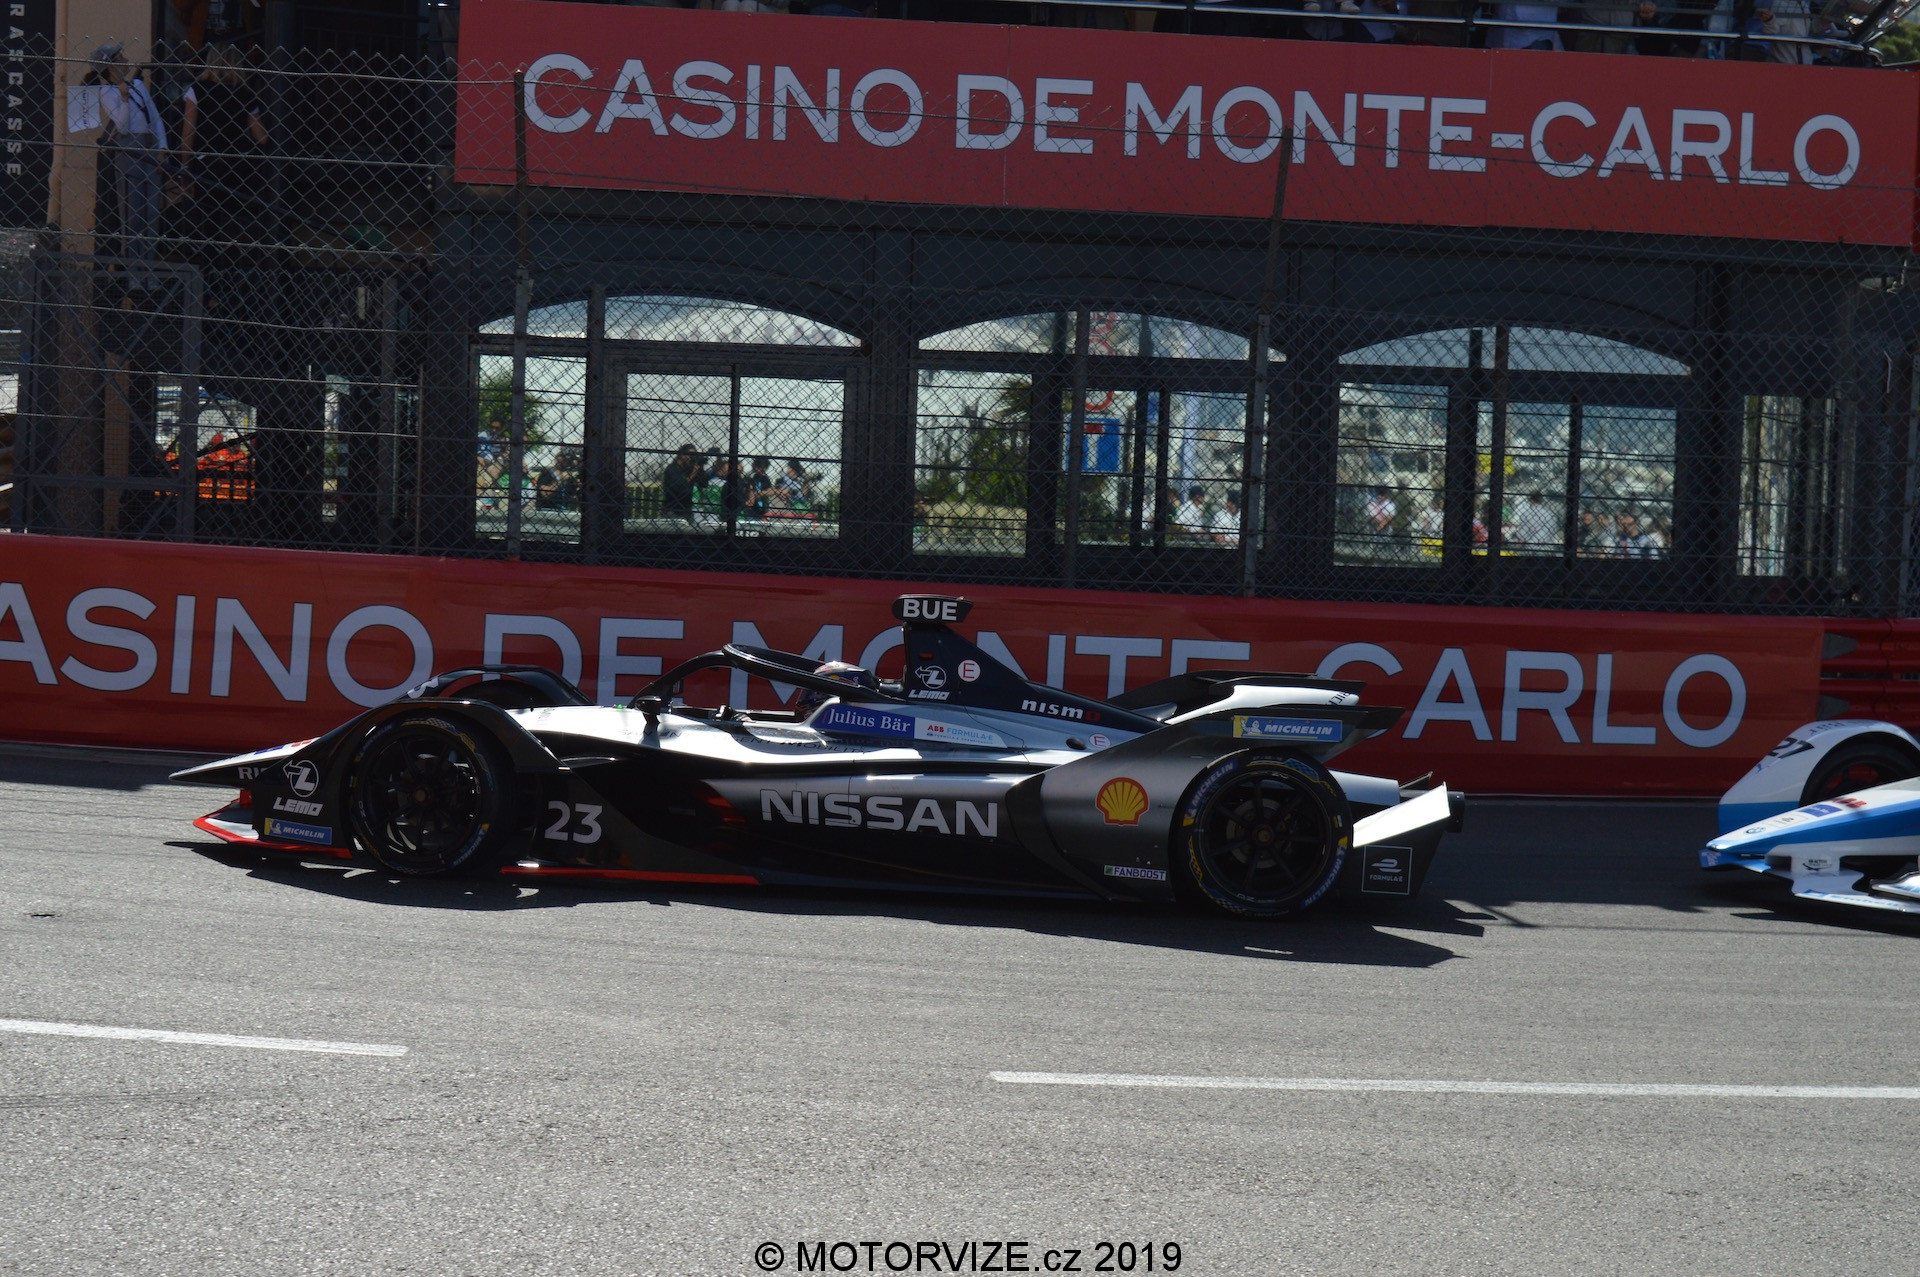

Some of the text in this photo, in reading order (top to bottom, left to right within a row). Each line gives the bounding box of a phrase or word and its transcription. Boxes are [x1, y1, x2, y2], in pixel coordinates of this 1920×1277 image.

[523, 52, 1861, 191] CASINO DE MONTE-CARLO
[903, 599, 957, 621] BUE
[963, 663, 975, 679] E
[908, 690, 950, 700] LEMO
[828, 708, 911, 732] Julius Bär
[927, 724, 944, 733] ABB
[1264, 724, 1333, 736] MICHELIN
[1191, 762, 1234, 807] MICHELIN
[273, 797, 323, 817] LEMO
[760, 788, 998, 837] NISSAN
[544, 800, 603, 844] 23
[283, 826, 325, 839] MICHELIN
[1113, 867, 1165, 880] FANBOOST
